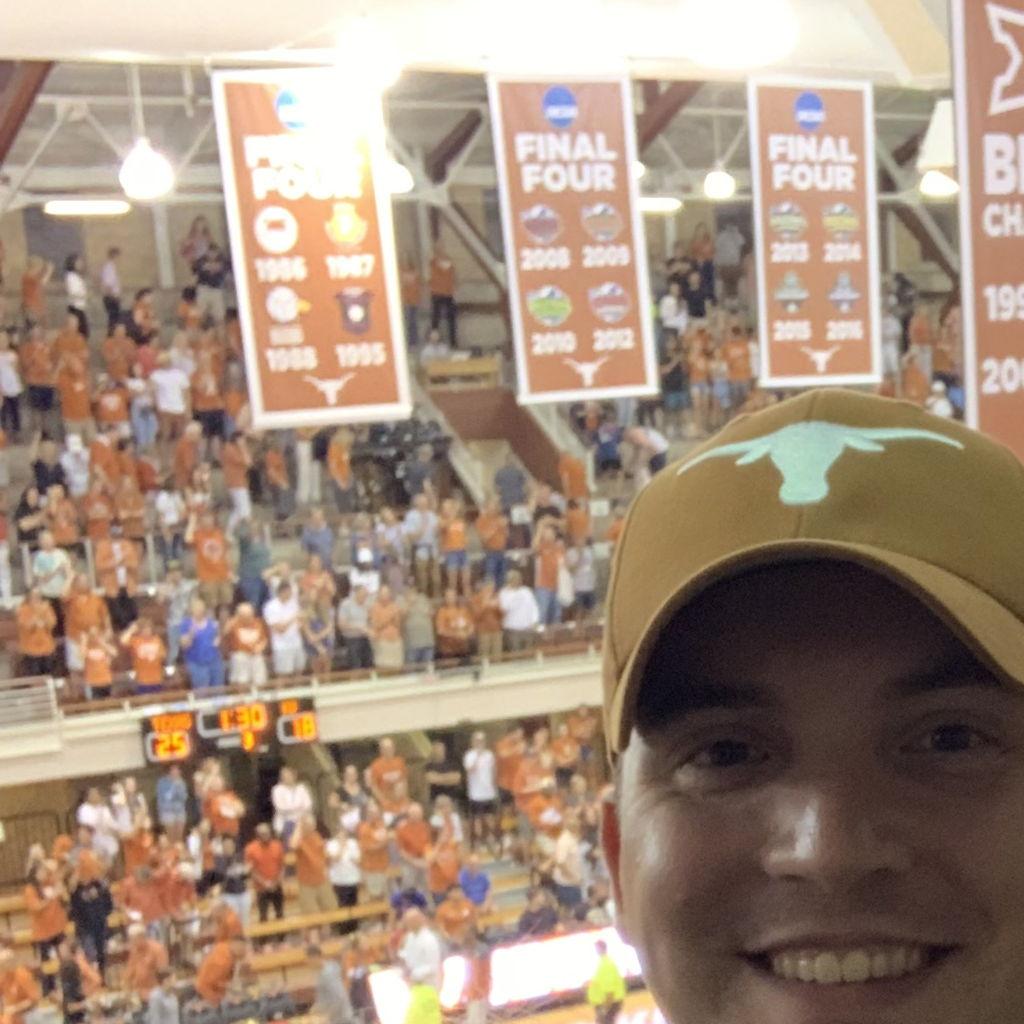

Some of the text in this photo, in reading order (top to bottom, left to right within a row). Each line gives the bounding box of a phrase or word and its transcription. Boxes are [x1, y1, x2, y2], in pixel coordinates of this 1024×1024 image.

[514, 131, 618, 162] FINAL
[768, 134, 858, 163] FINAL
[520, 162, 616, 193] FOUR
[773, 163, 856, 191] FOUR
[154, 731, 190, 760] 25
